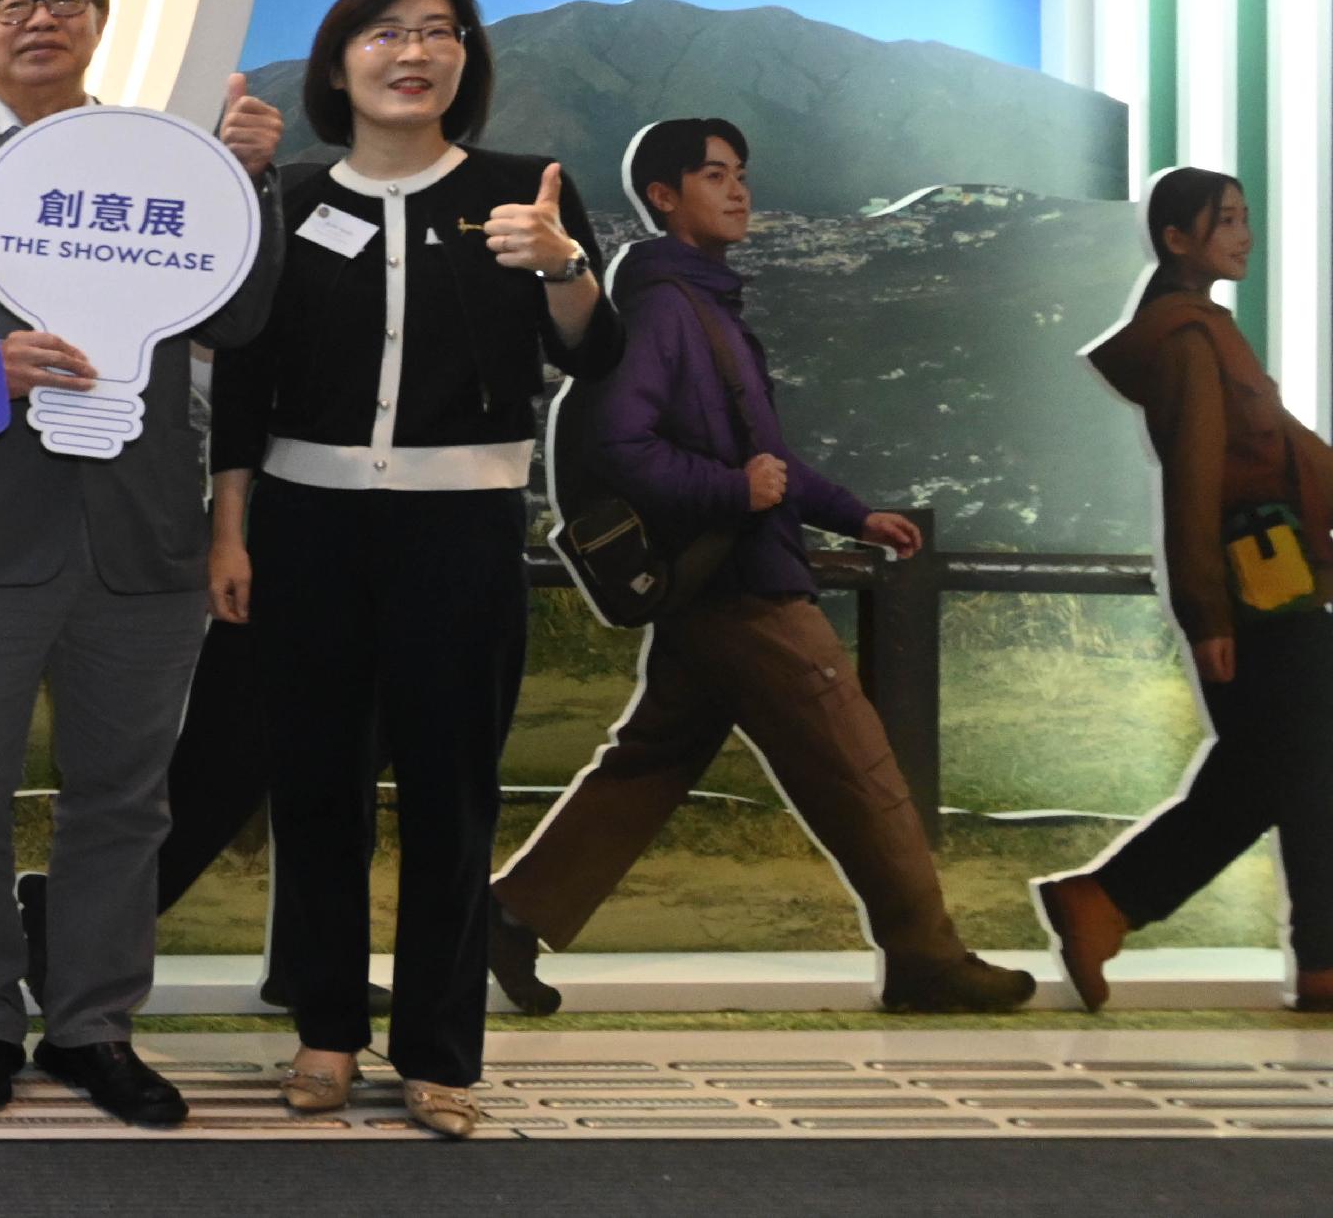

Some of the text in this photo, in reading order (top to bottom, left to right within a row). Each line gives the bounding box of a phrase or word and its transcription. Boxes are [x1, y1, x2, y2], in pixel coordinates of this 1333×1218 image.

[36, 188, 187, 238] 創意展
[0, 235, 216, 272] THE SHOWCASE
